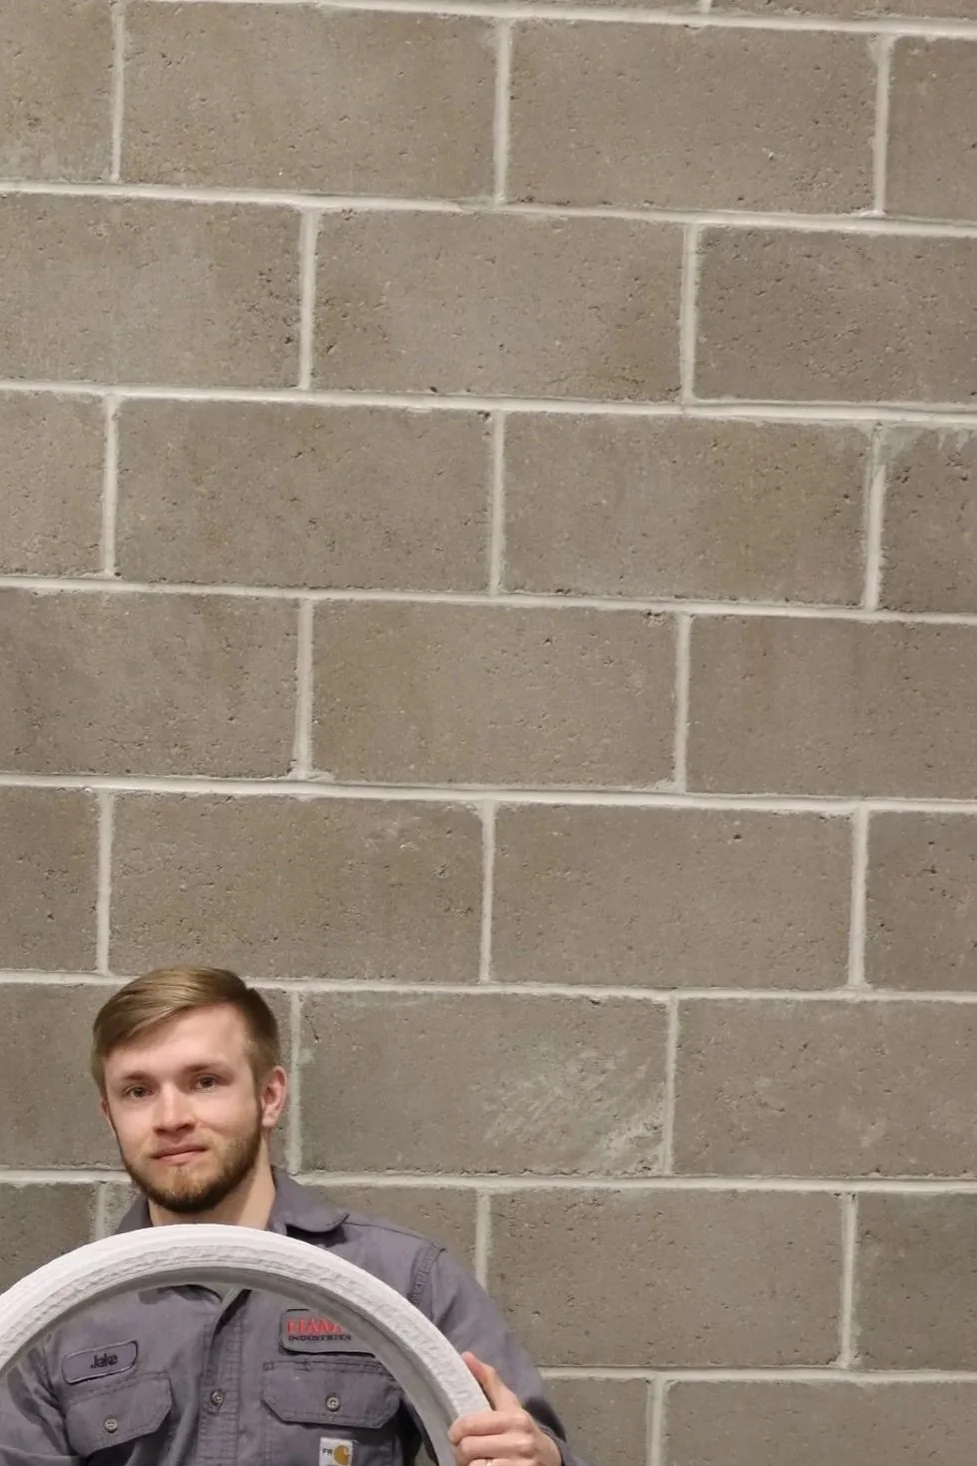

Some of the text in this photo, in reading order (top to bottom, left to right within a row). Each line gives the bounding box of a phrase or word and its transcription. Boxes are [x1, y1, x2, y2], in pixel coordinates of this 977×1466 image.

[288, 1334, 352, 1342] INDUSTRIES
[90, 1353, 119, 1369] Jake
[322, 1447, 333, 1456] FR
